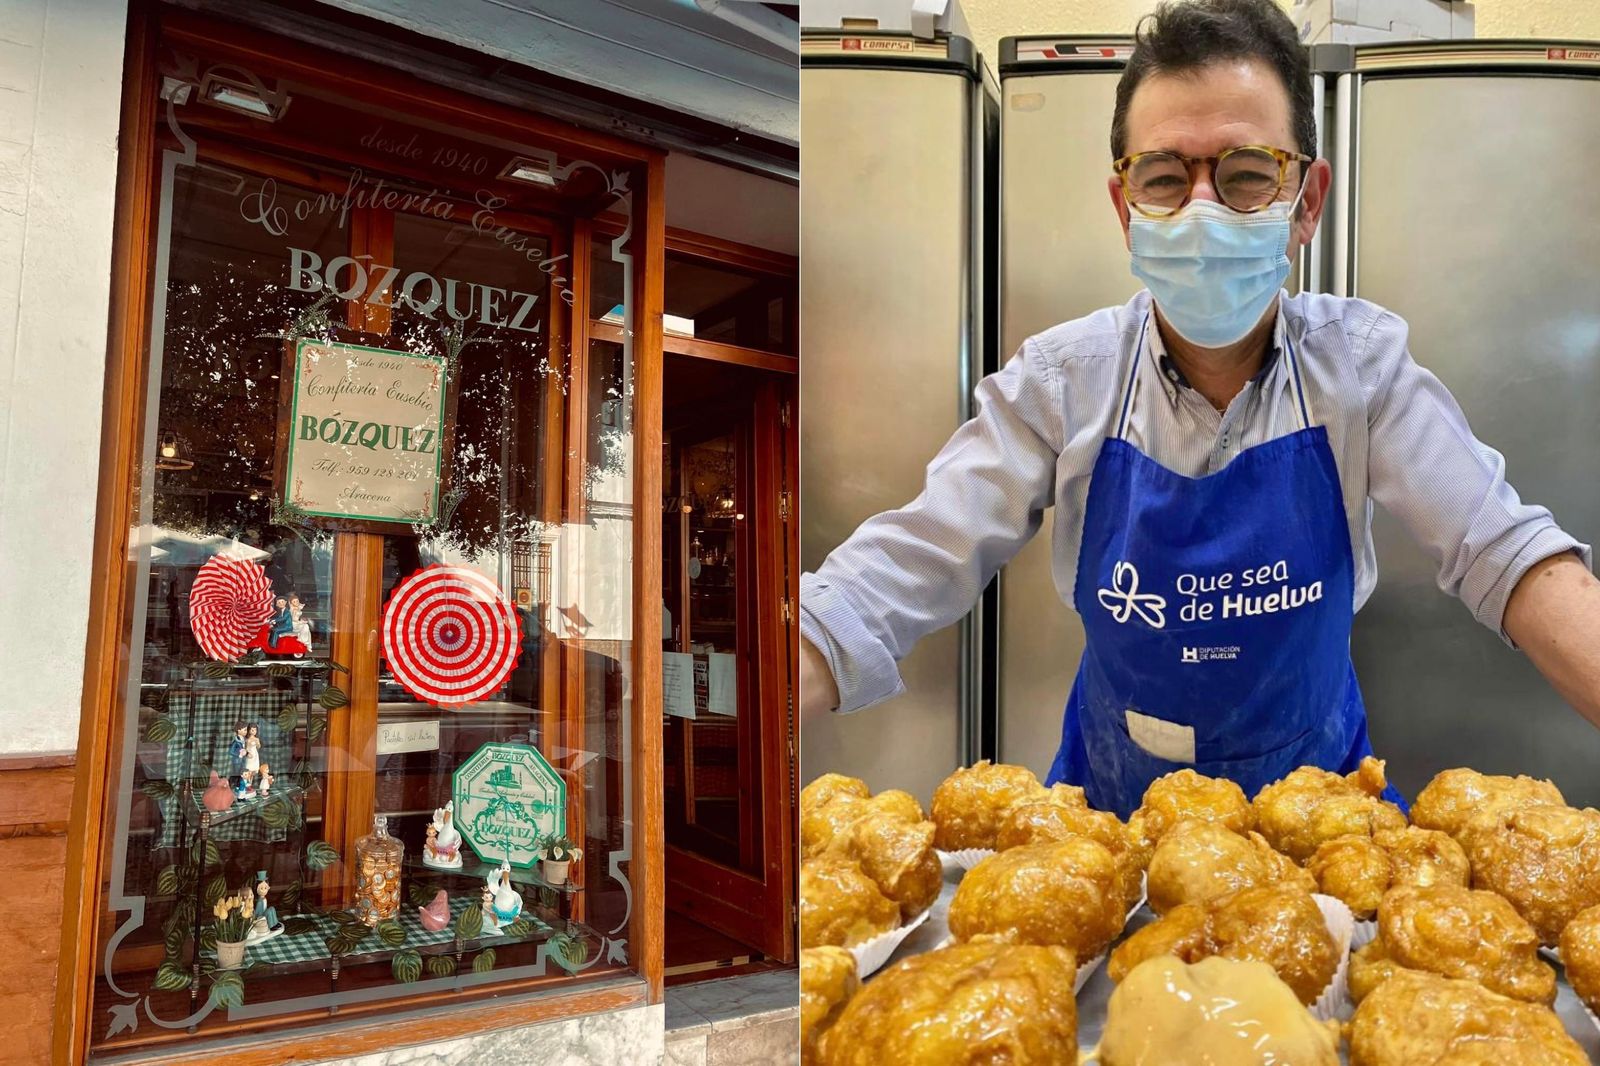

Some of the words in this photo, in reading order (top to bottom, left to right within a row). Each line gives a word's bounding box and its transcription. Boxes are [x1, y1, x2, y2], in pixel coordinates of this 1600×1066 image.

[863, 41, 910, 50] comersa
[360, 125, 423, 160] desde
[432, 145, 488, 176] 1940
[240, 168, 455, 236] Confitería
[285, 246, 541, 334] BÓZQUEZ
[378, 361, 403, 371] 1940
[307, 374, 379, 401] Confitería
[387, 380, 433, 410] Eusebio
[298, 412, 436, 454] BÓZQUEZ
[346, 465, 370, 475] 959
[373, 468, 394, 478] 128
[339, 485, 392, 502] Aracena
[1176, 572, 1233, 597] Que
[1241, 560, 1289, 587] sea
[1179, 598, 1214, 622] de
[1222, 580, 1323, 619] Huelva
[1210, 652, 1238, 660] HUELVA
